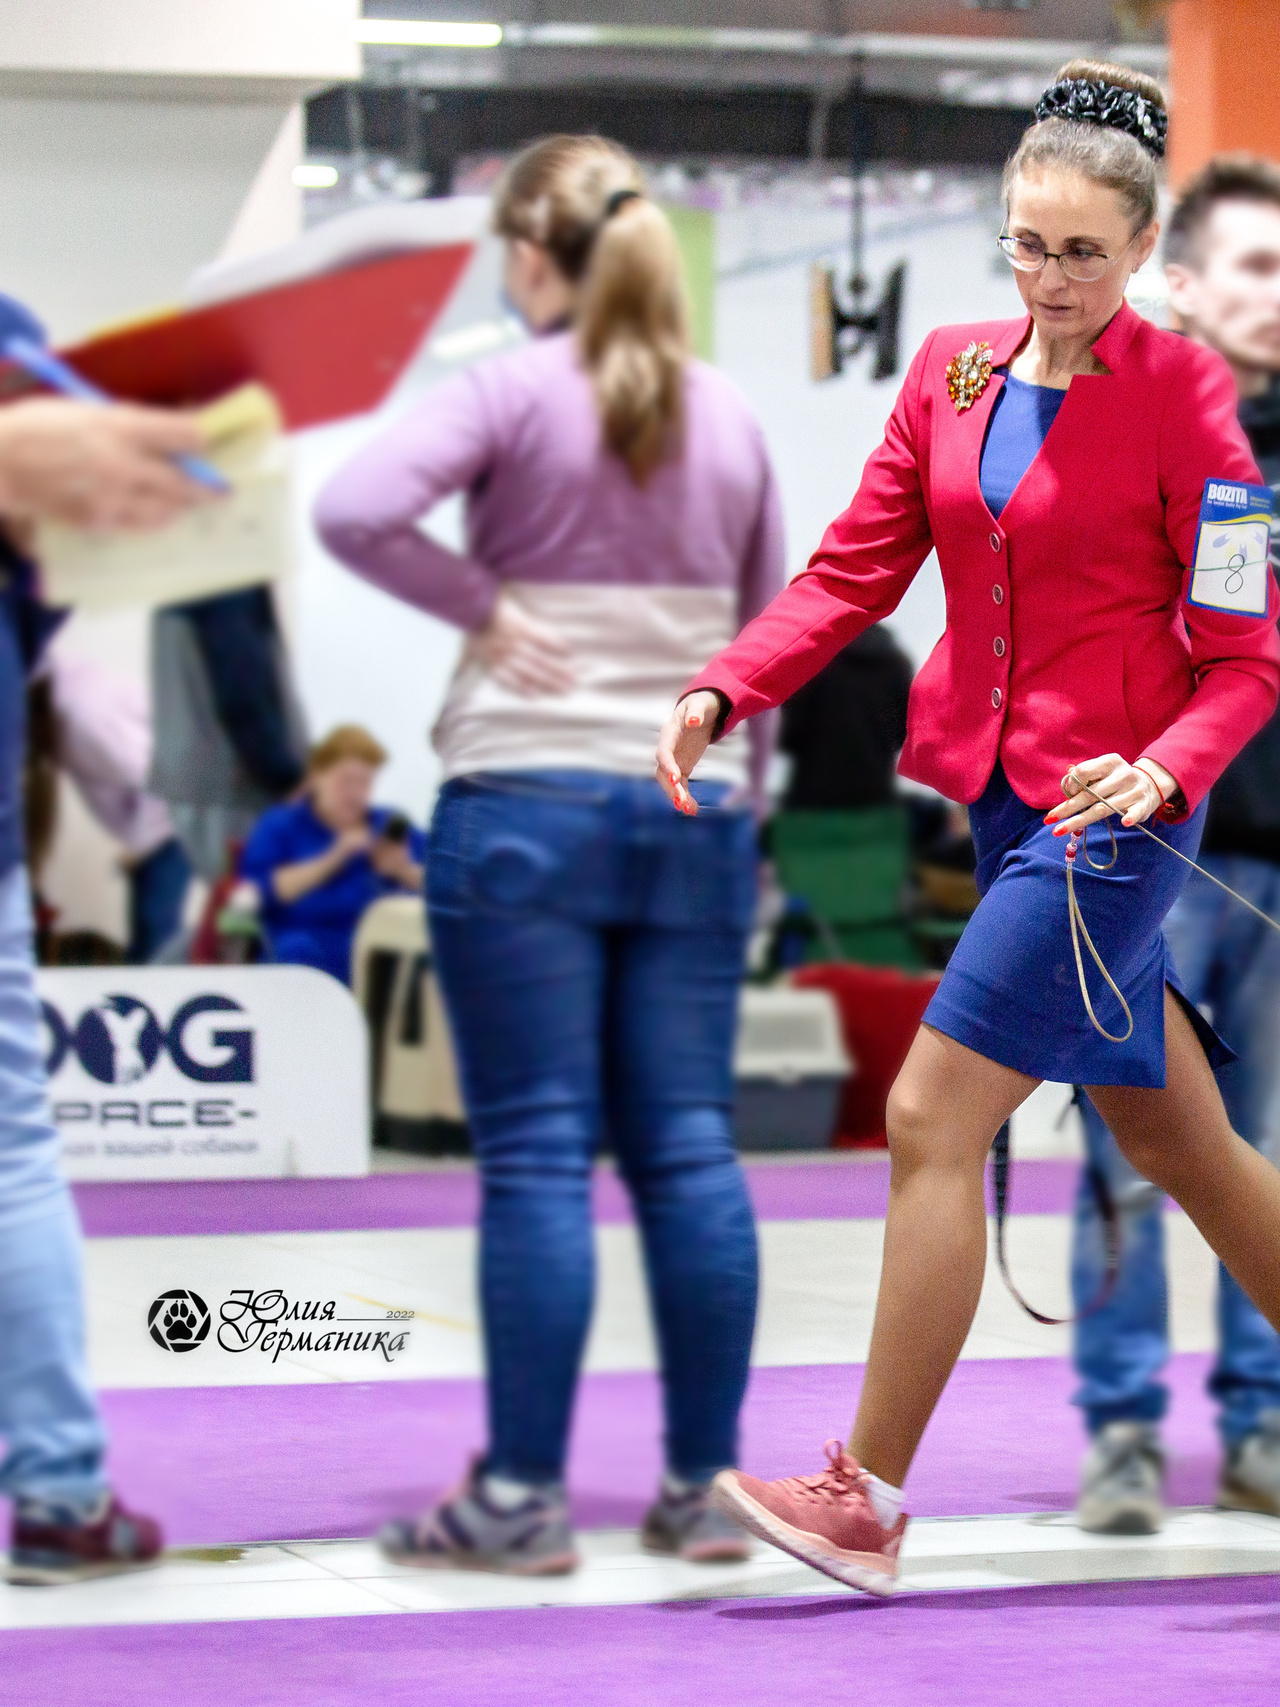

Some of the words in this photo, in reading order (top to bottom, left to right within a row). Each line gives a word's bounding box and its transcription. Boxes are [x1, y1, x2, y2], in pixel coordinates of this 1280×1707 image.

[1207, 483, 1248, 504] BOZITA
[1225, 553, 1245, 594] 8
[53, 1099, 257, 1128] PACE-
